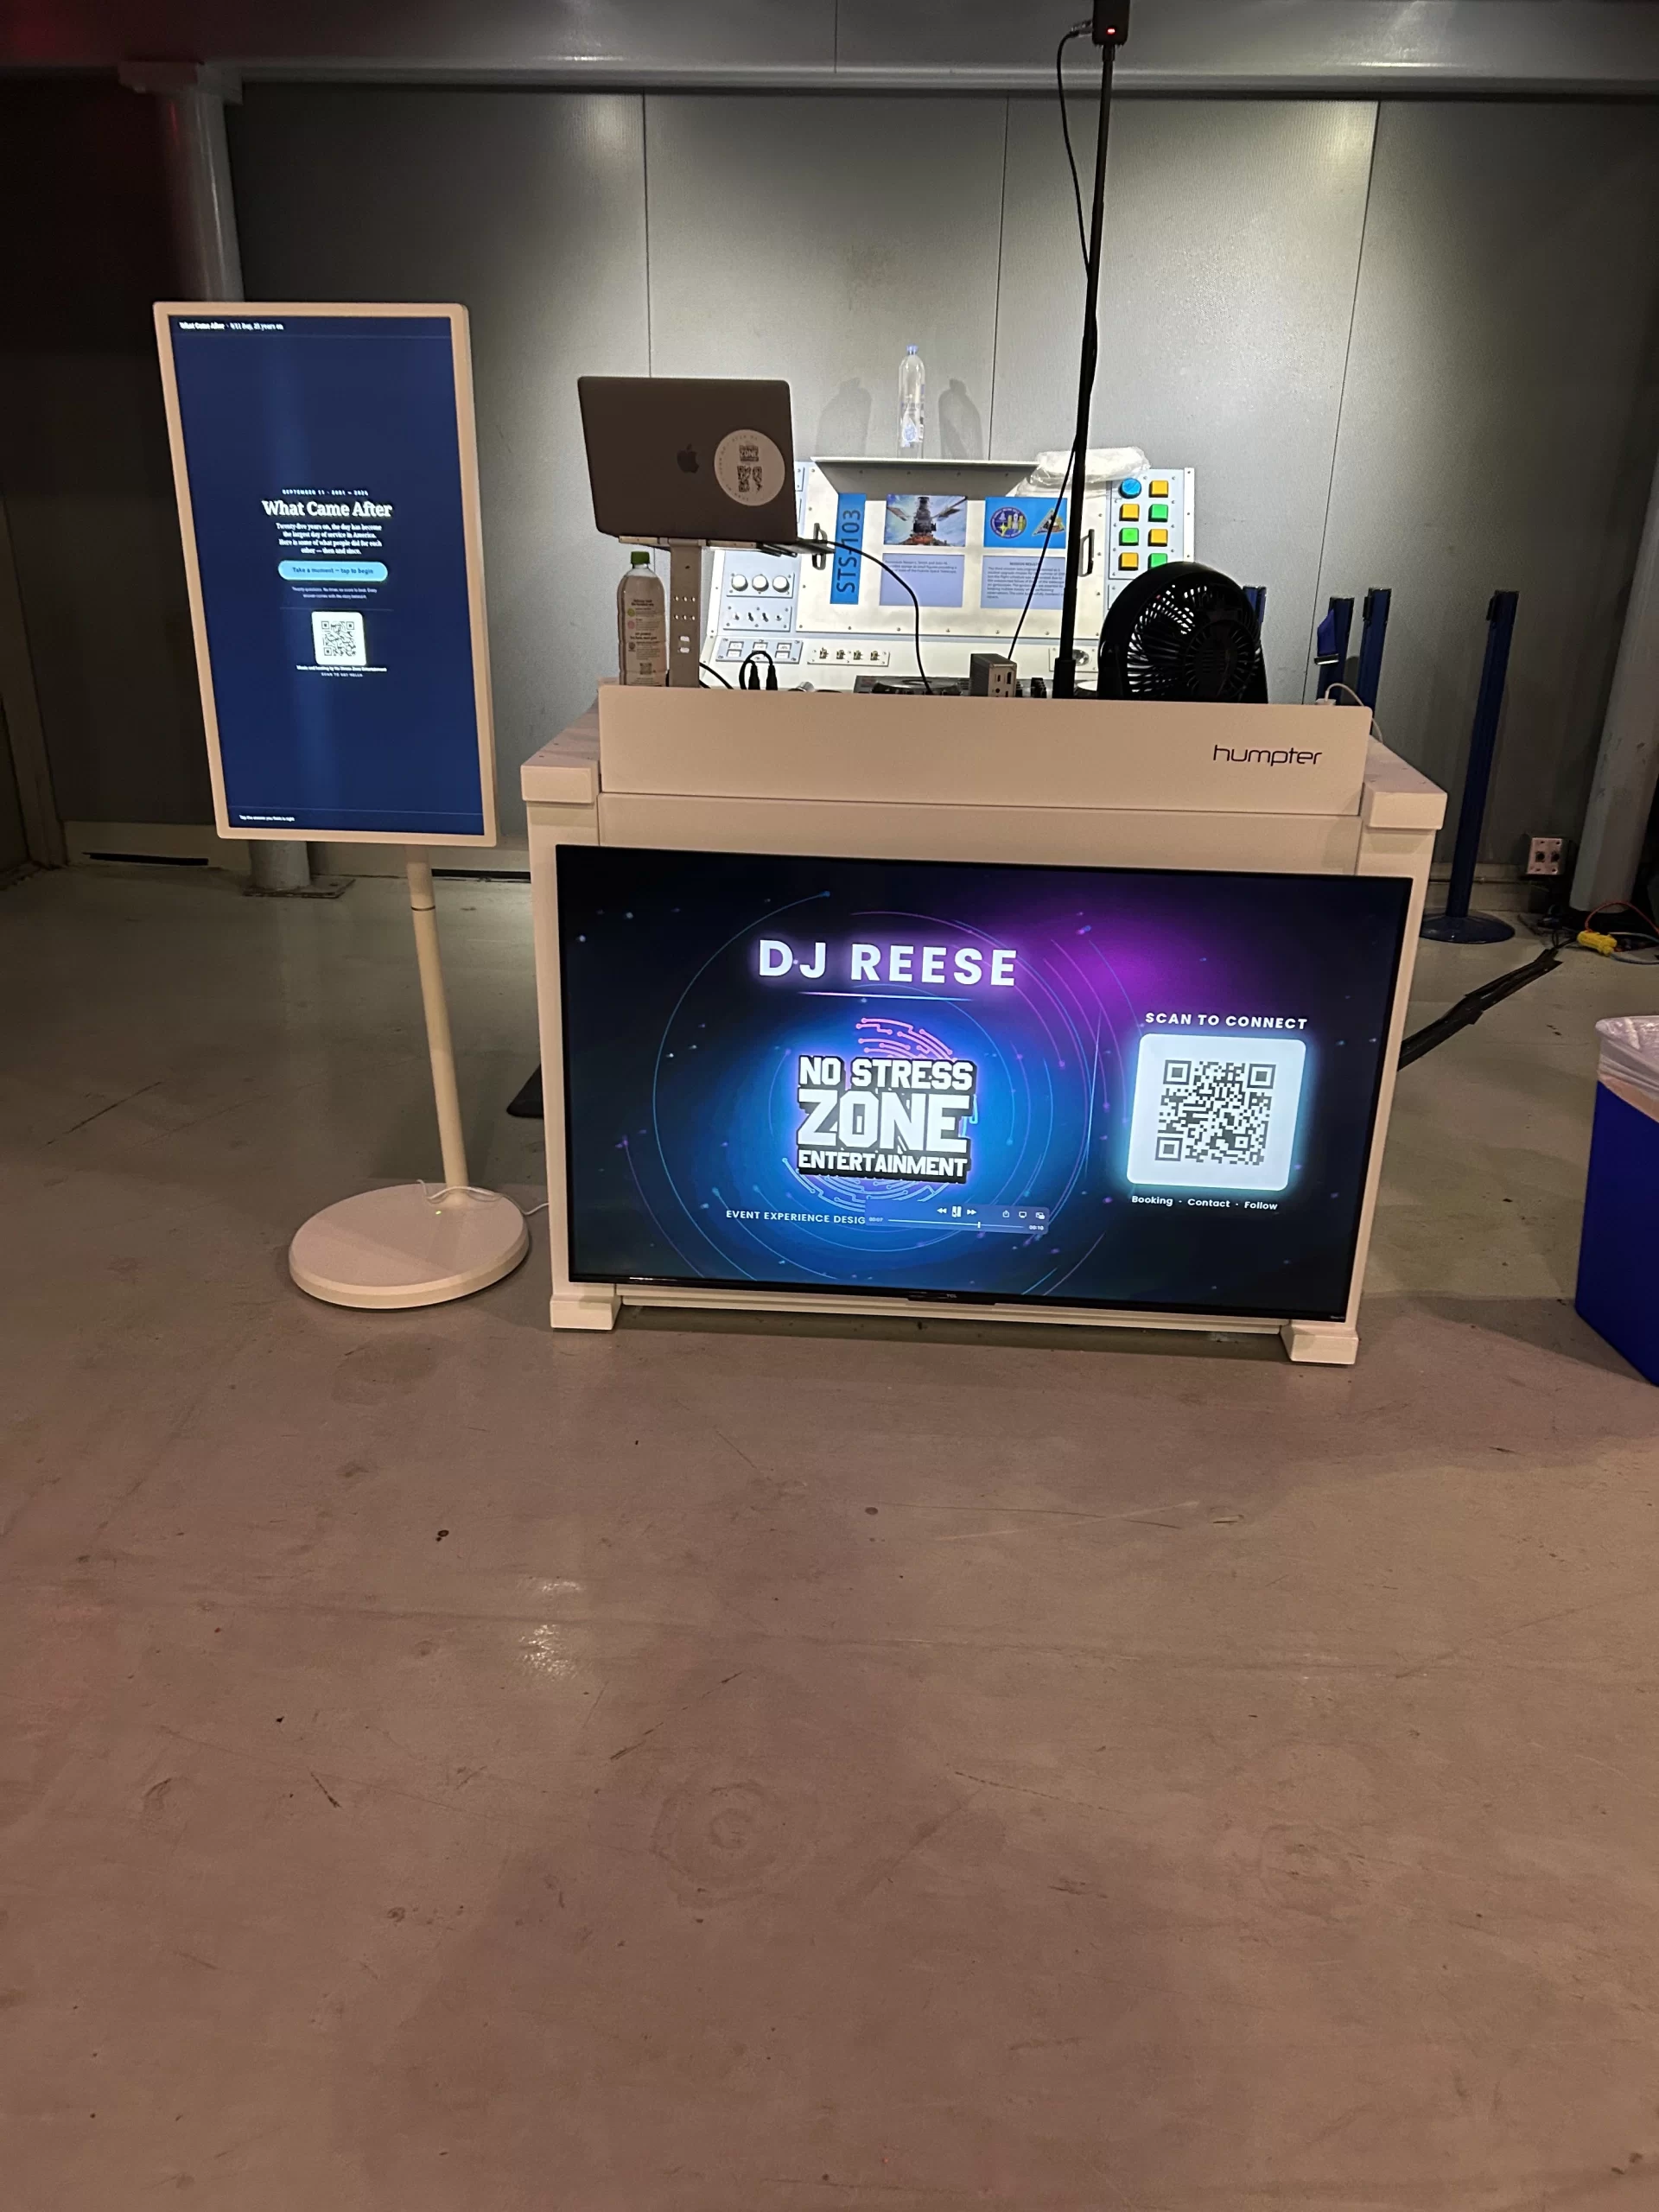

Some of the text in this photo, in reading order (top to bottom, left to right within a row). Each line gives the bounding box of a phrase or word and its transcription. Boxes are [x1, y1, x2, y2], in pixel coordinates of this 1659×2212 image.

[261, 499, 393, 518] What Came After
[1213, 744, 1323, 766] humpter
[759, 939, 1017, 986] DJ REESE
[1145, 1012, 1308, 1030] SCAN TO CONNECT
[799, 1057, 974, 1091] NO STRESS
[797, 1088, 970, 1154] ZONE
[798, 1149, 969, 1178] ENTERTAINMENT
[1131, 1195, 1278, 1211] Booking Contact Follow
[726, 1210, 761, 1219] EVENT
[763, 1211, 830, 1223] EXPERIENCE
